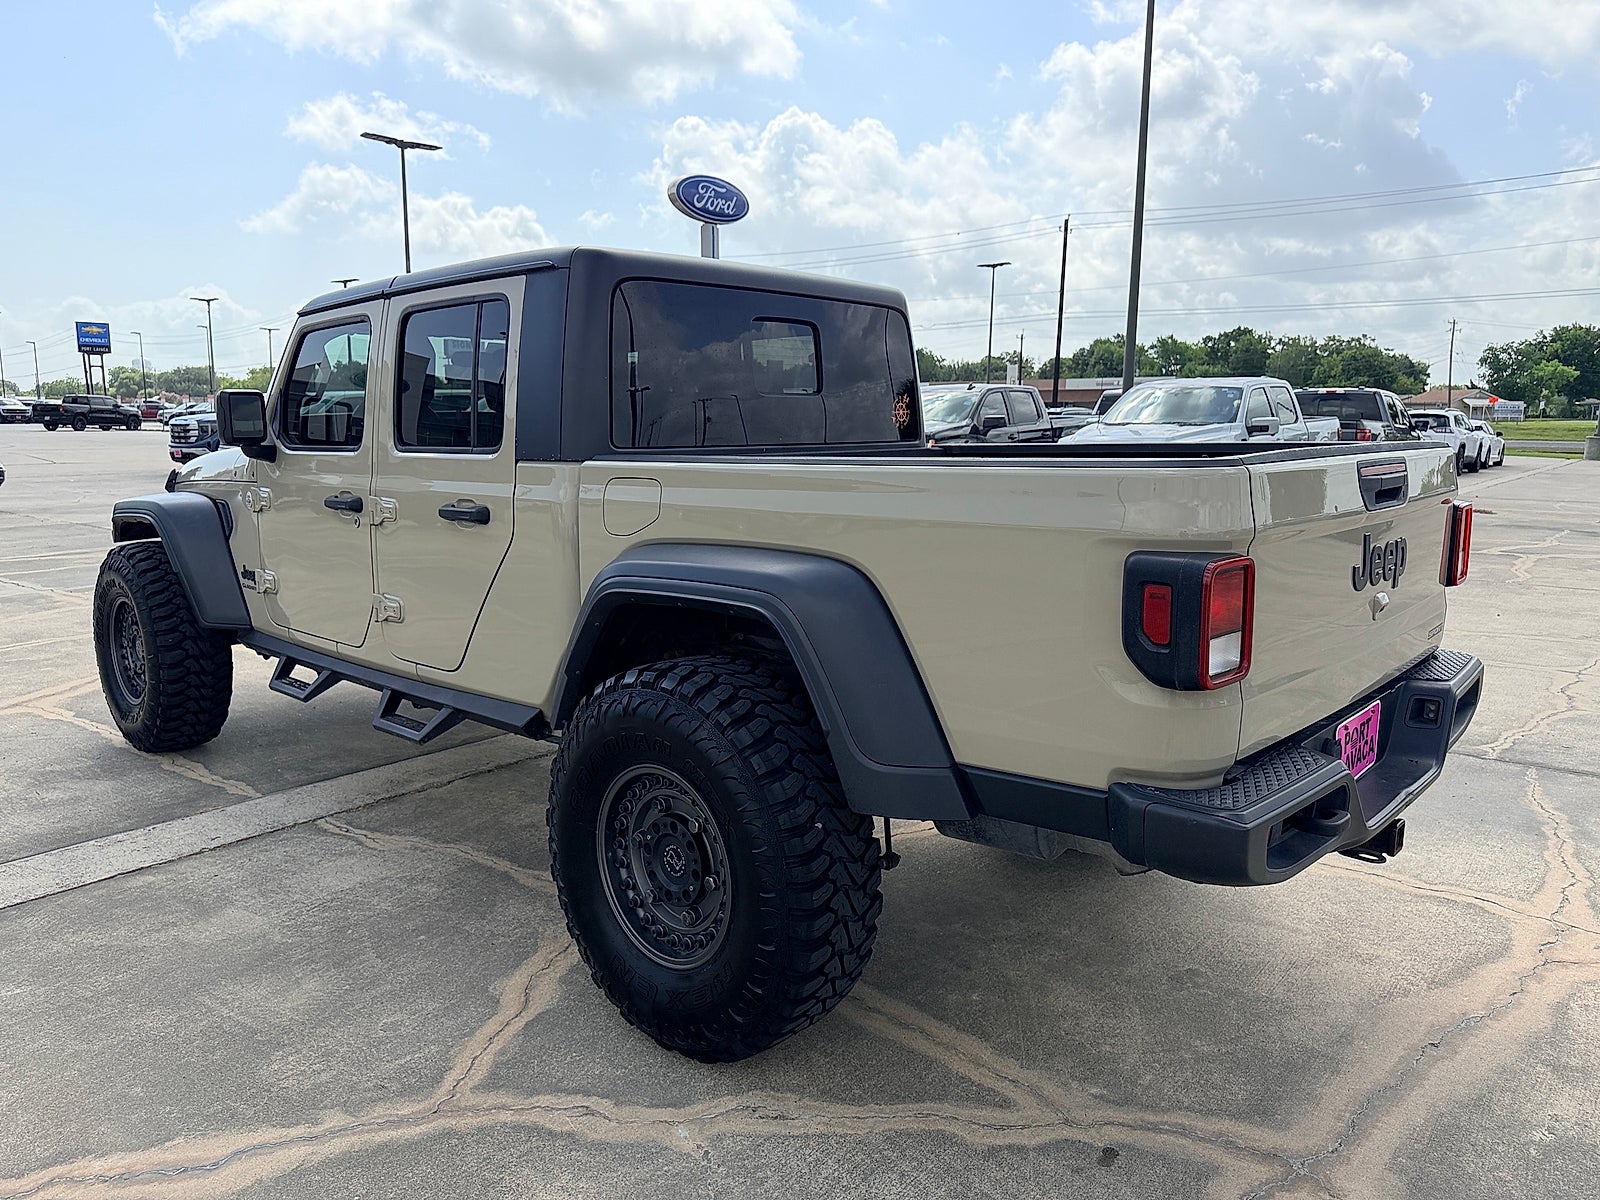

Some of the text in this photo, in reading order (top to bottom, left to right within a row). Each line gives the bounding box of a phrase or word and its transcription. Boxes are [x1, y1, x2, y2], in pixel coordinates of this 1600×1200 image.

[693, 182, 738, 214] Ford
[1352, 531, 1407, 592] Jeep
[1344, 715, 1373, 754] PORT
[1345, 734, 1375, 772] AVACA
